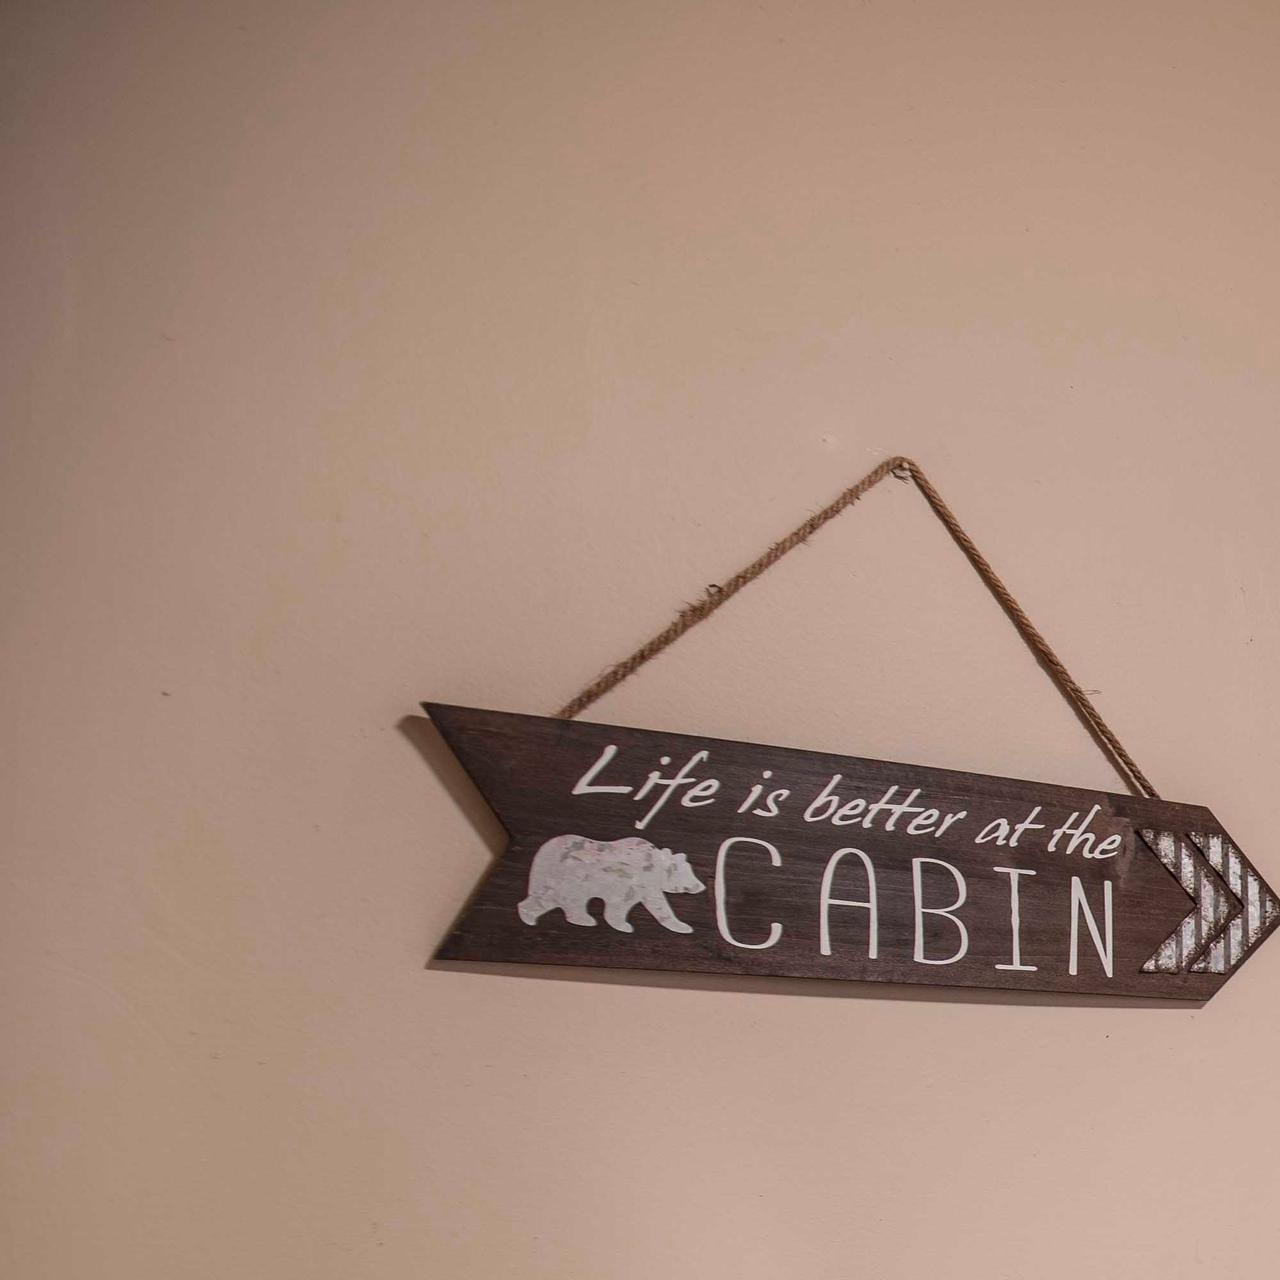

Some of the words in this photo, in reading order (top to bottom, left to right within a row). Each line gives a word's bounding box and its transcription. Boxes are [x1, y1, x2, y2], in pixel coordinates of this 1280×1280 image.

[572, 744, 718, 831] Life
[739, 770, 789, 817] is
[803, 773, 969, 838] better
[974, 808, 1043, 849] at
[1047, 803, 1123, 860] the
[714, 836, 1114, 978] CABIN
